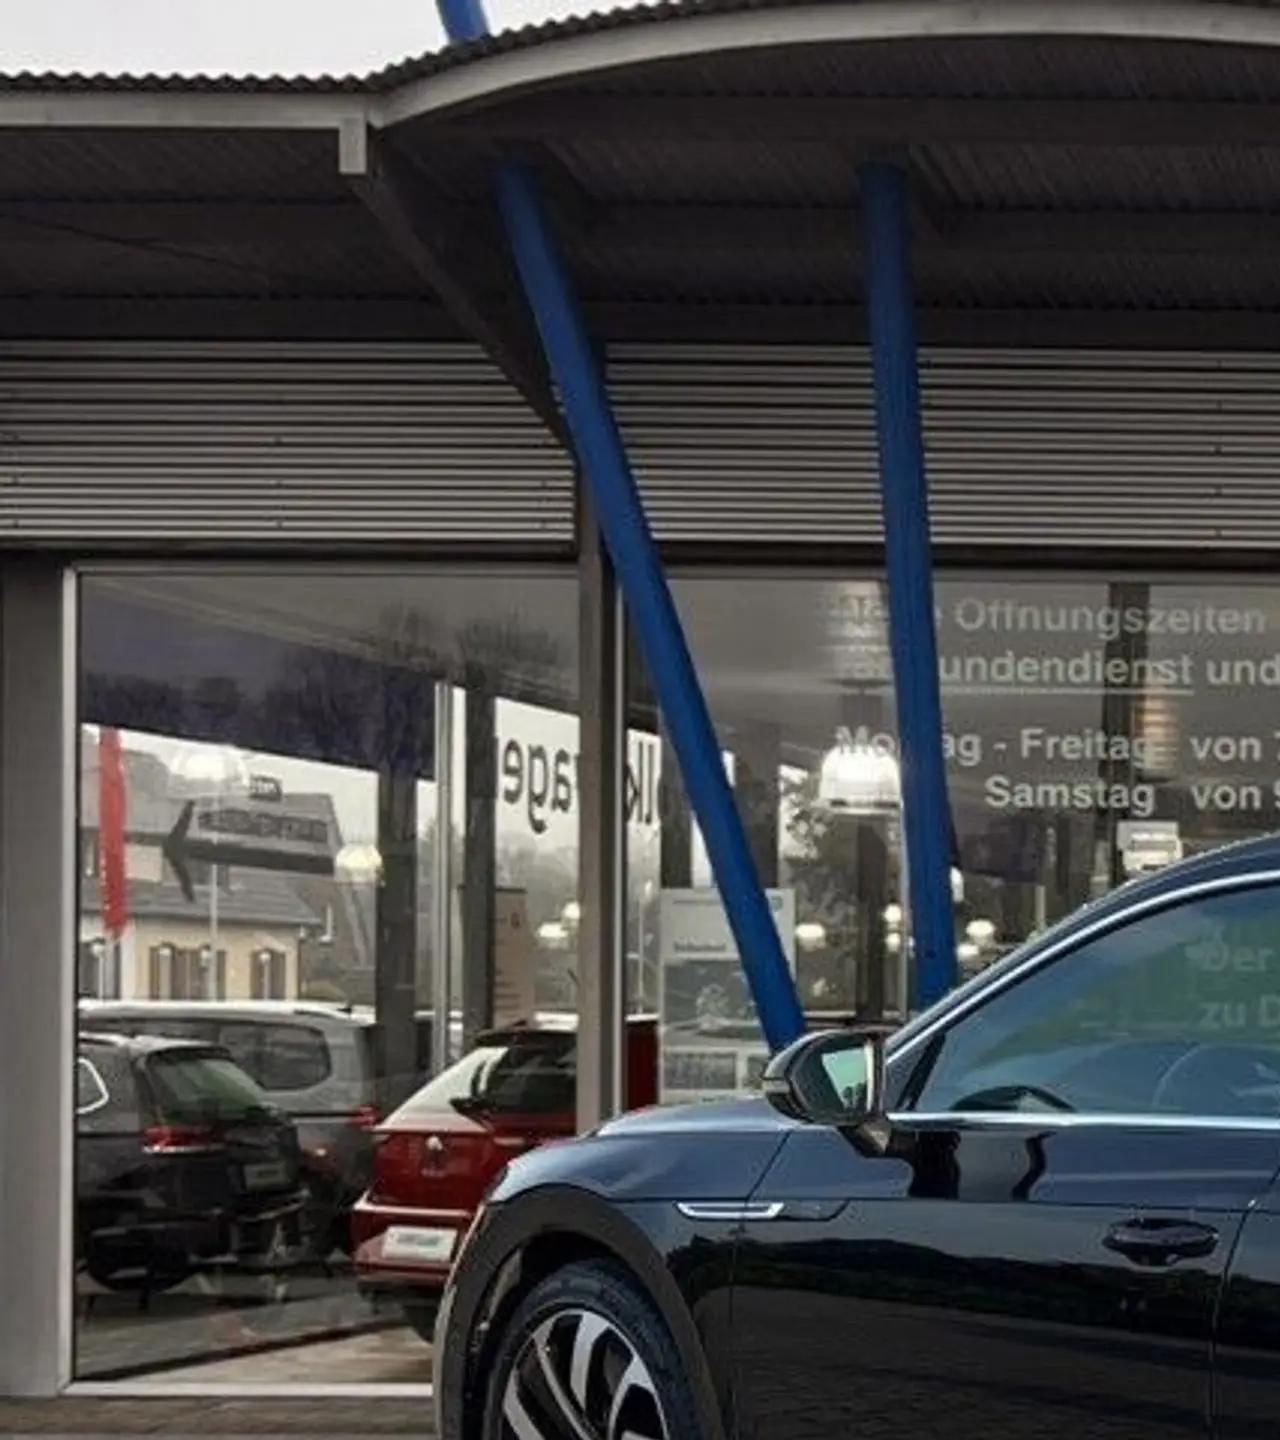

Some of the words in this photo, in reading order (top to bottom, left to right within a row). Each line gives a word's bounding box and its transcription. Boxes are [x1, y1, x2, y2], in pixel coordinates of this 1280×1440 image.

[939, 650, 1195, 686] undendienst
[832, 724, 982, 767] Moag
[1019, 728, 1152, 768] Freitag
[1189, 736, 1262, 763] von
[984, 775, 1155, 817] Samstag
[1189, 784, 1262, 811] von
[1202, 1002, 1245, 1028] zu
